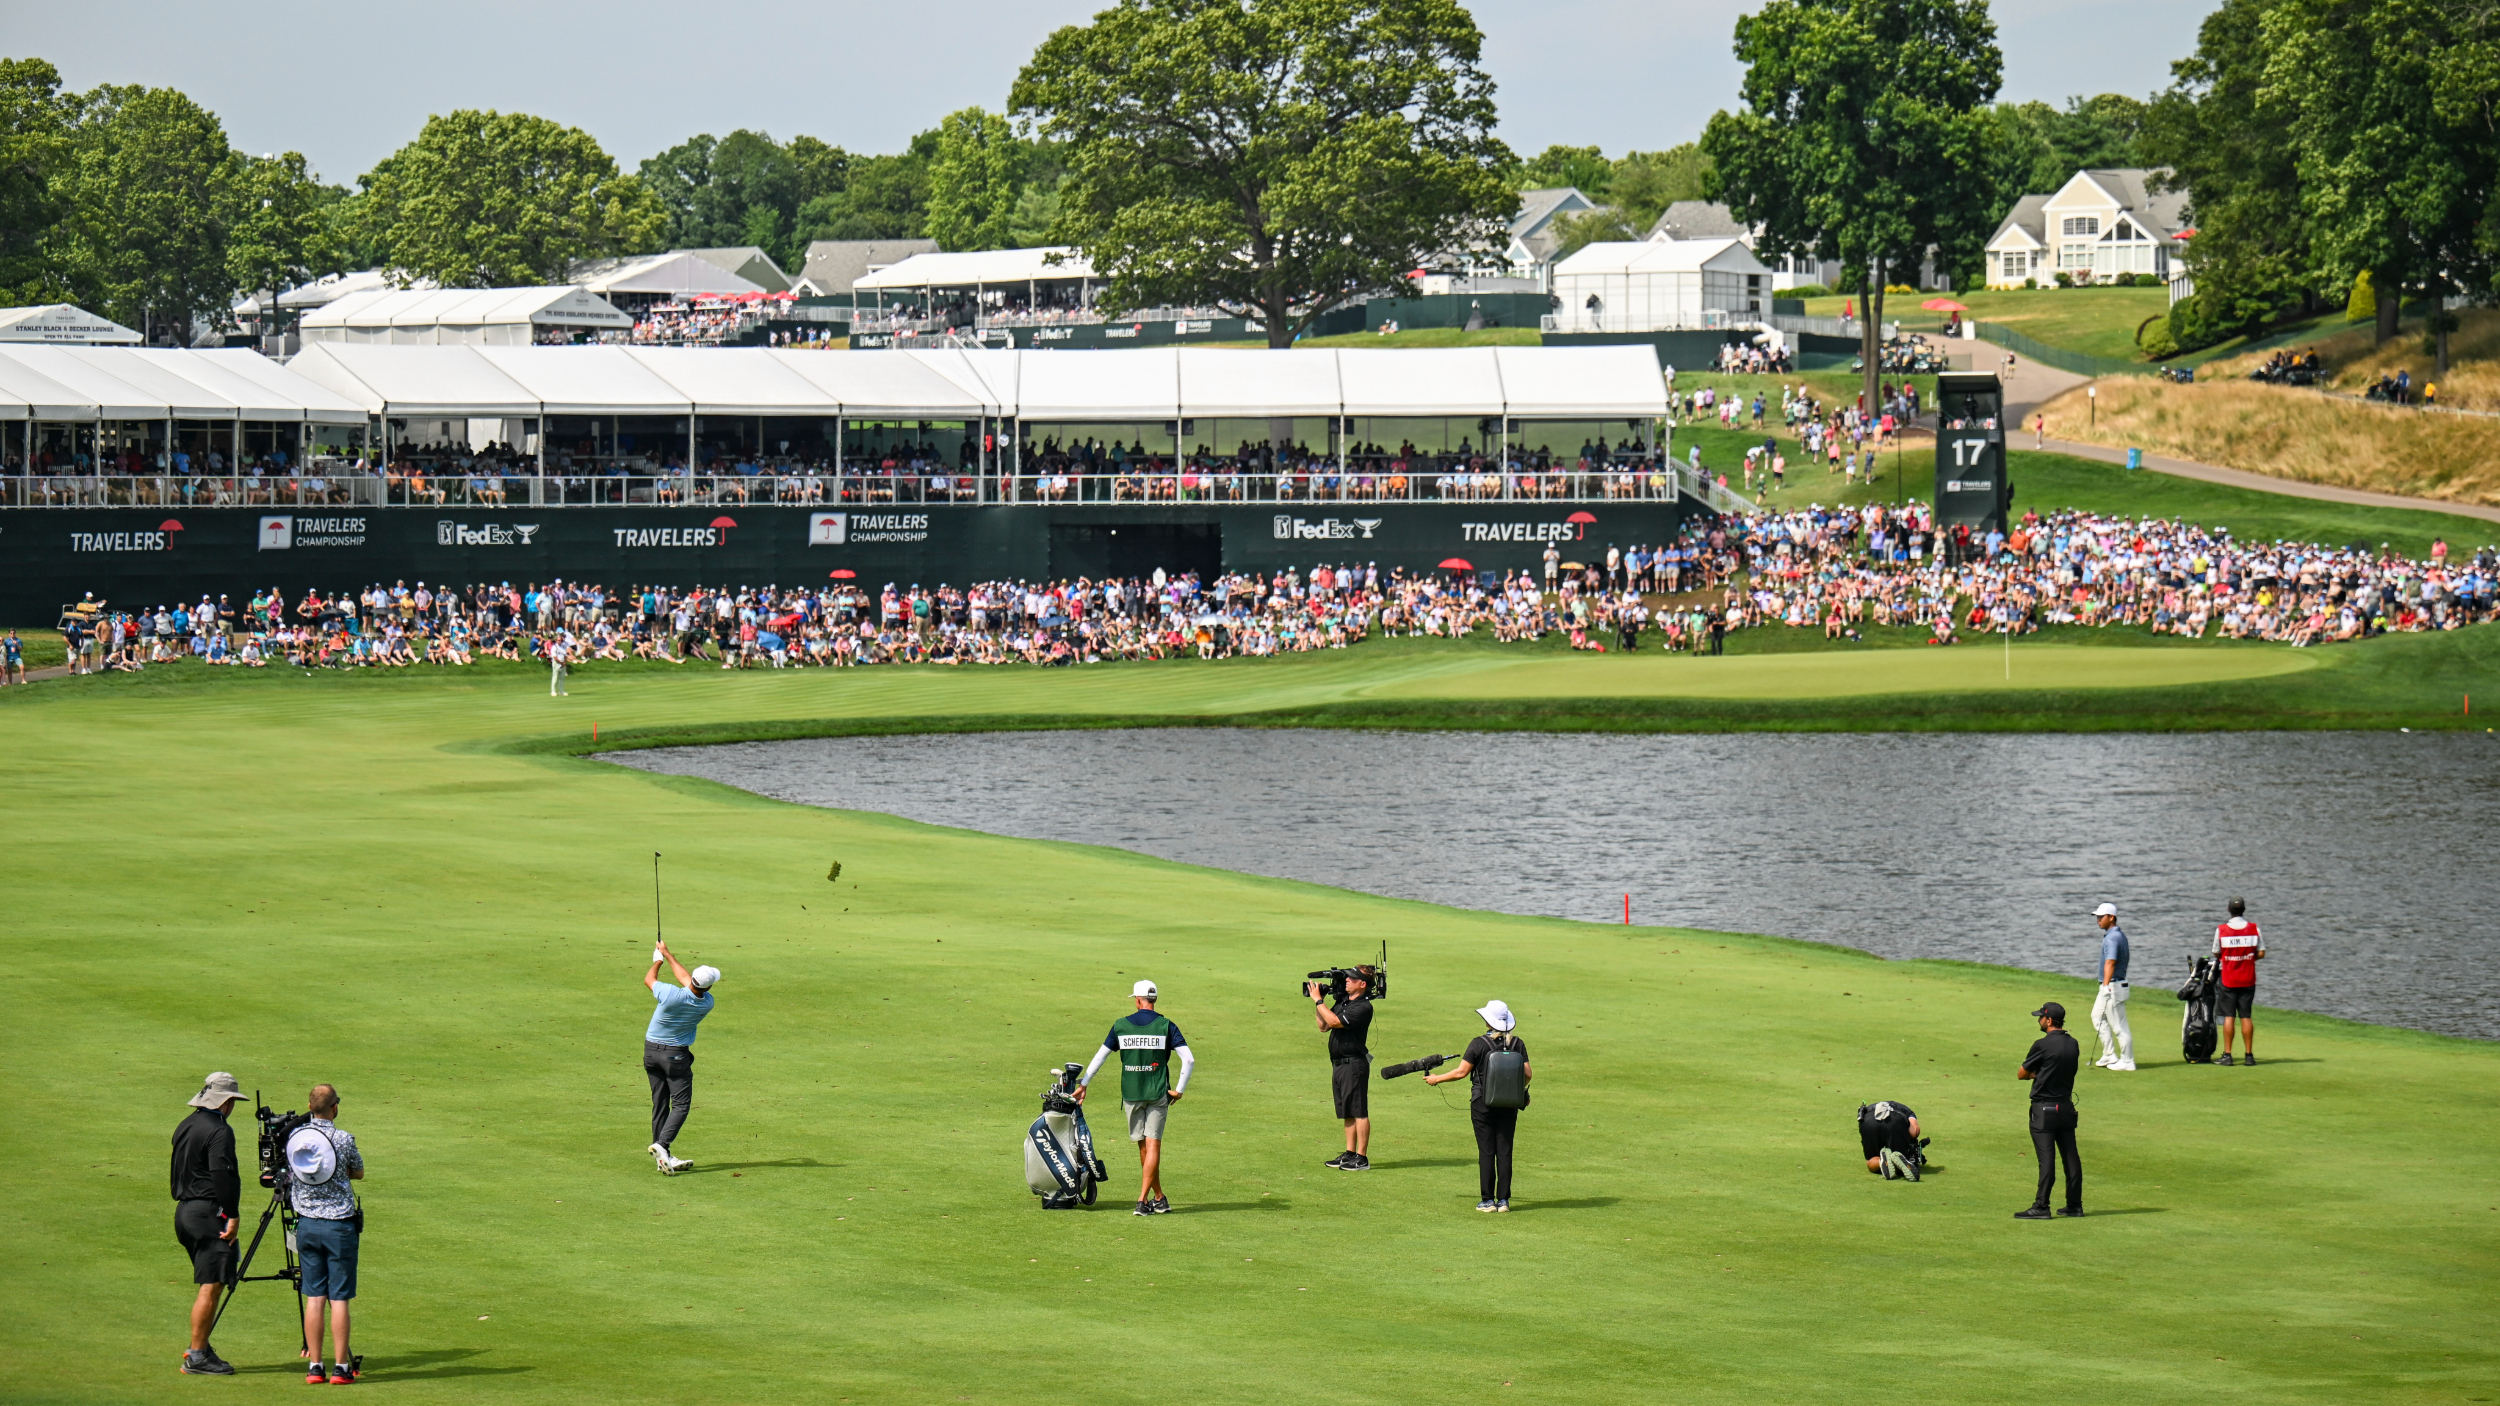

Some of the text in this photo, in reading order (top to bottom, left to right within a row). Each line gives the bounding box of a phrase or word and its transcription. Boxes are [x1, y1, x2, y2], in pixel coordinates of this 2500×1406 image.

[1105, 329, 1136, 338] TRAVELERS
[1187, 320, 1212, 328] TRAVELERS
[1952, 439, 1986, 466] 17
[296, 517, 366, 533] TRAVELERS
[851, 514, 929, 530] TRAVELERS
[1293, 518, 1355, 539] FedEx
[1461, 522, 1575, 541] TRAVELERS
[71, 531, 165, 552] TRAVELERS
[296, 536, 366, 547] CHAMPIONSHIP
[456, 524, 514, 545] FedEx
[613, 528, 717, 547] TRAVELERS
[851, 532, 928, 542] CHAMPIONSHIP
[1123, 1037, 1161, 1047] SCHEFFLER
[1035, 1128, 1076, 1189] TaylorMade
[1079, 1134, 1101, 1179] TaylorMade
